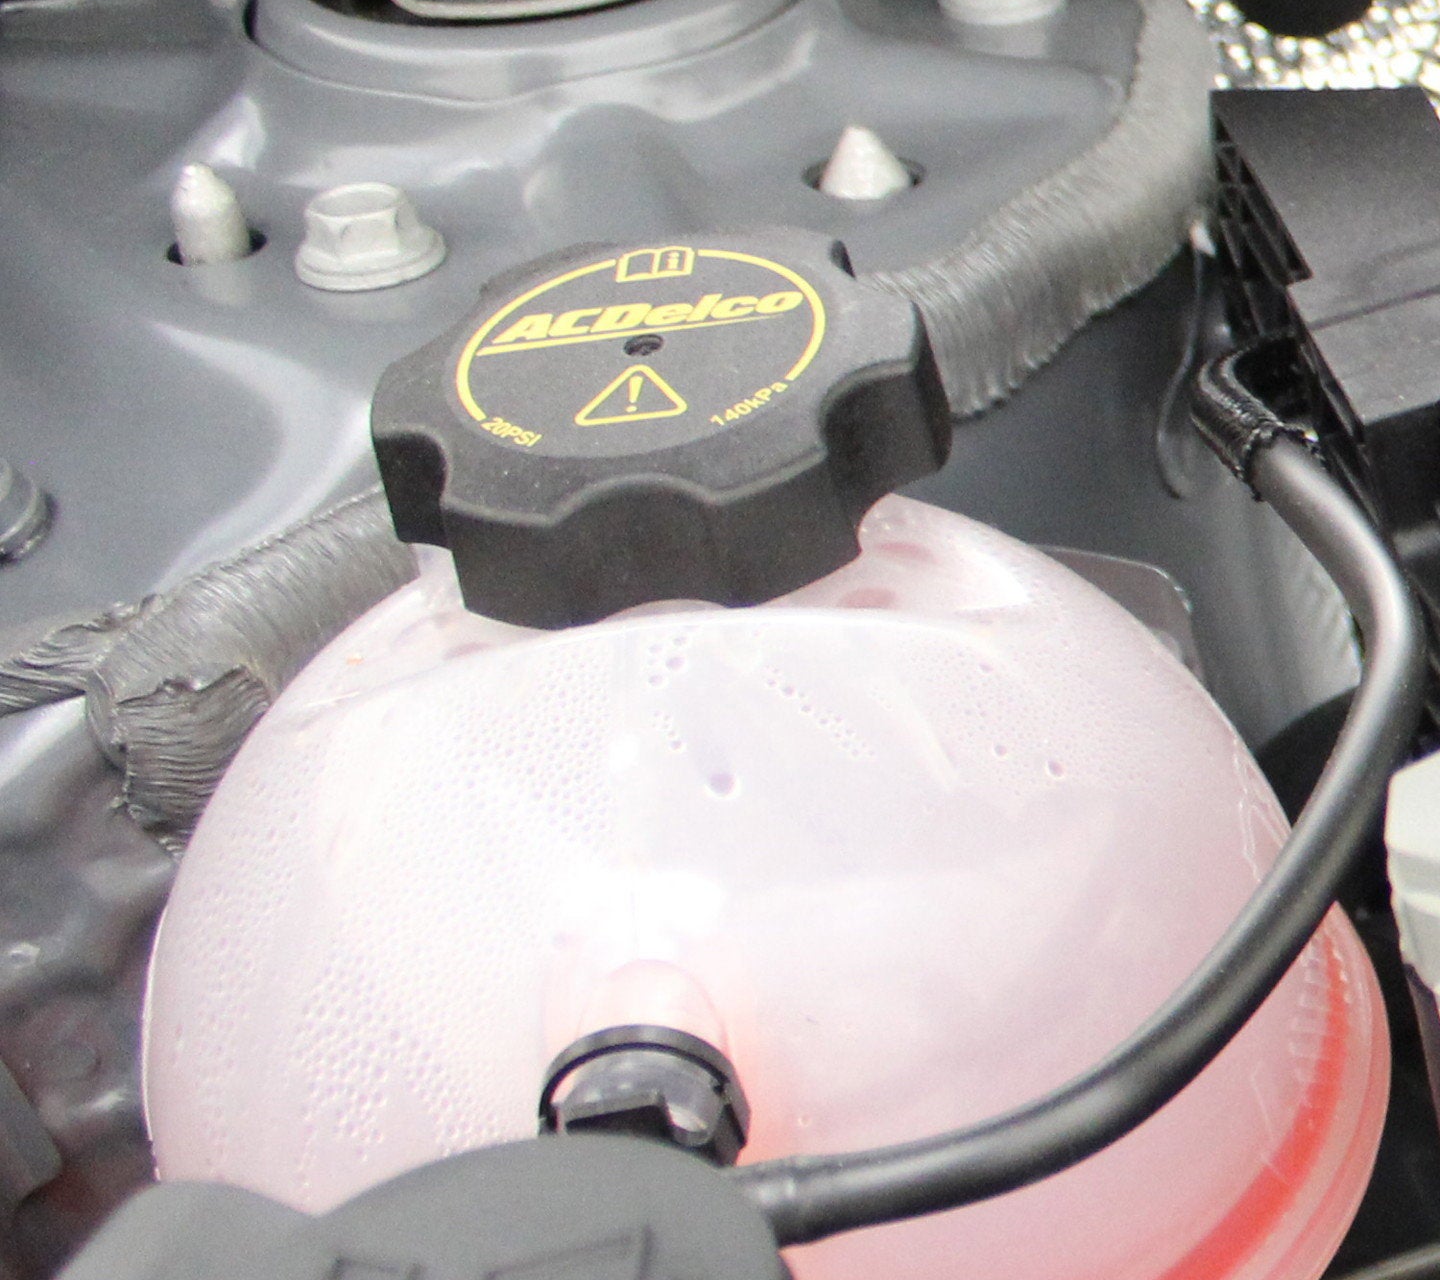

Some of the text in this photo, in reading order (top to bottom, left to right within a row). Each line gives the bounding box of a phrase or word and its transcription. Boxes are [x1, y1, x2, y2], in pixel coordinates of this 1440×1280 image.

[490, 290, 805, 345] ACDelco
[709, 380, 789, 428] 140kPa
[480, 416, 543, 448] 20PSI
